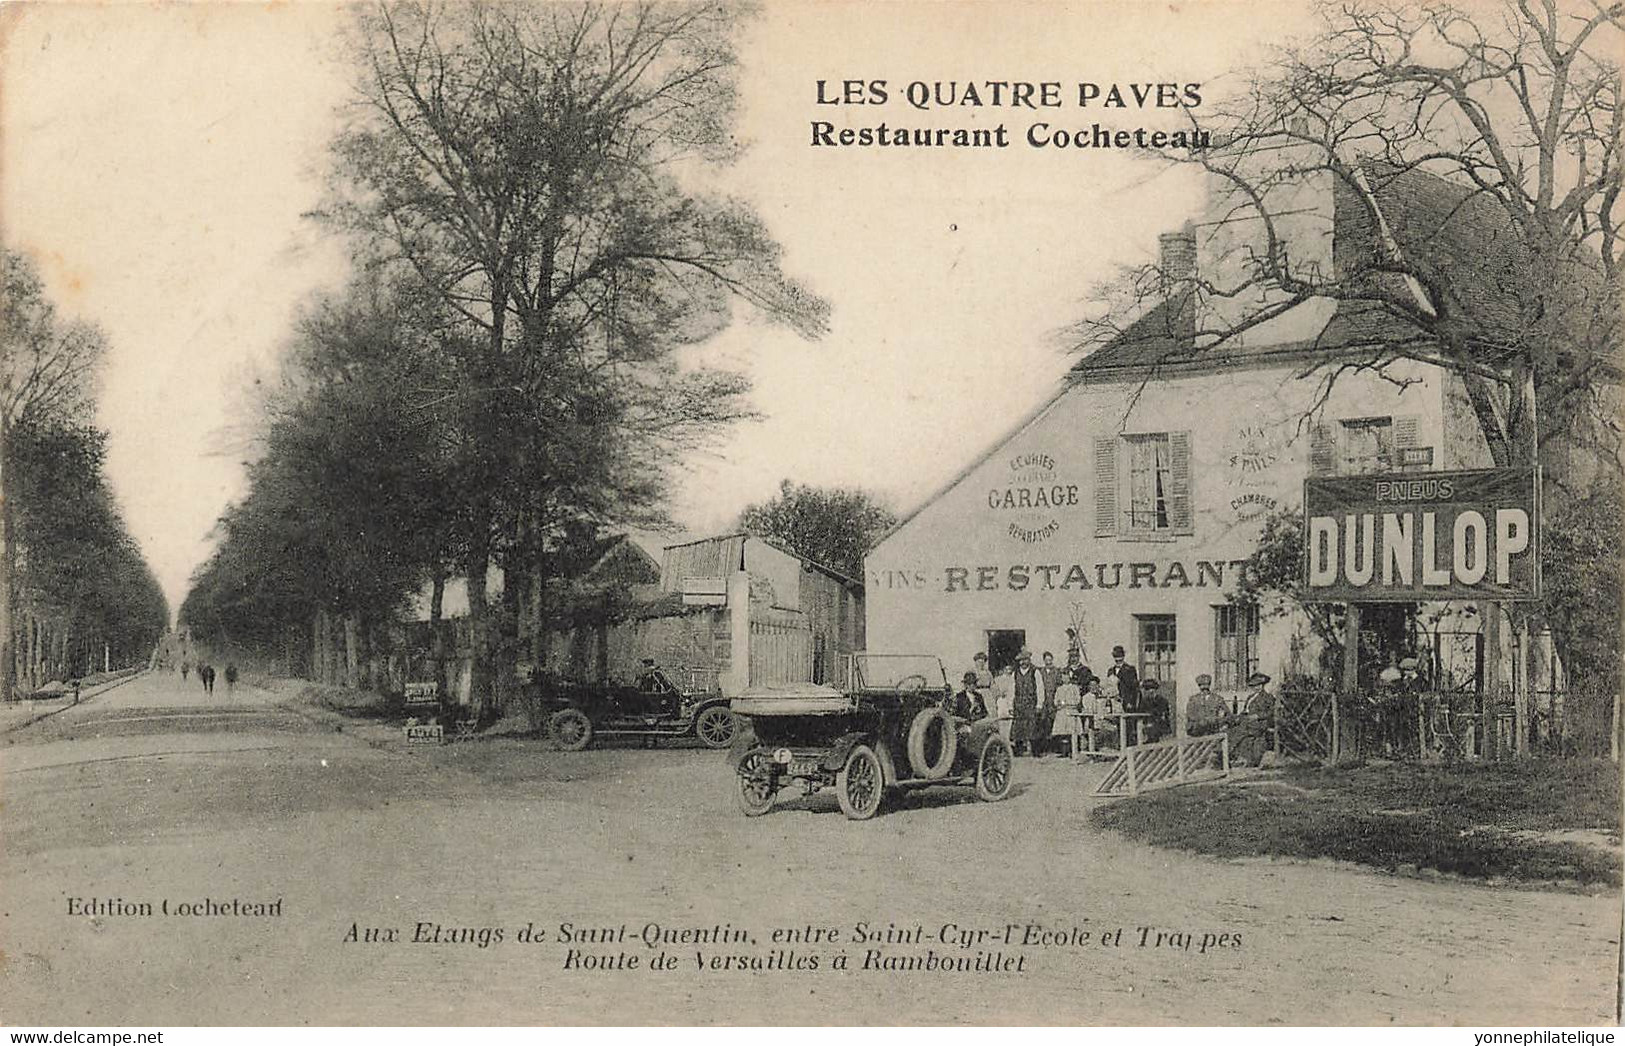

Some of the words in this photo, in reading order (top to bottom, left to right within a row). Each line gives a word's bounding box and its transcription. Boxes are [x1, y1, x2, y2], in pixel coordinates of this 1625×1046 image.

[988, 485, 1079, 509] GARAGE
[1376, 480, 1454, 501] PNEUS
[1309, 508, 1529, 588] DUNLOP
